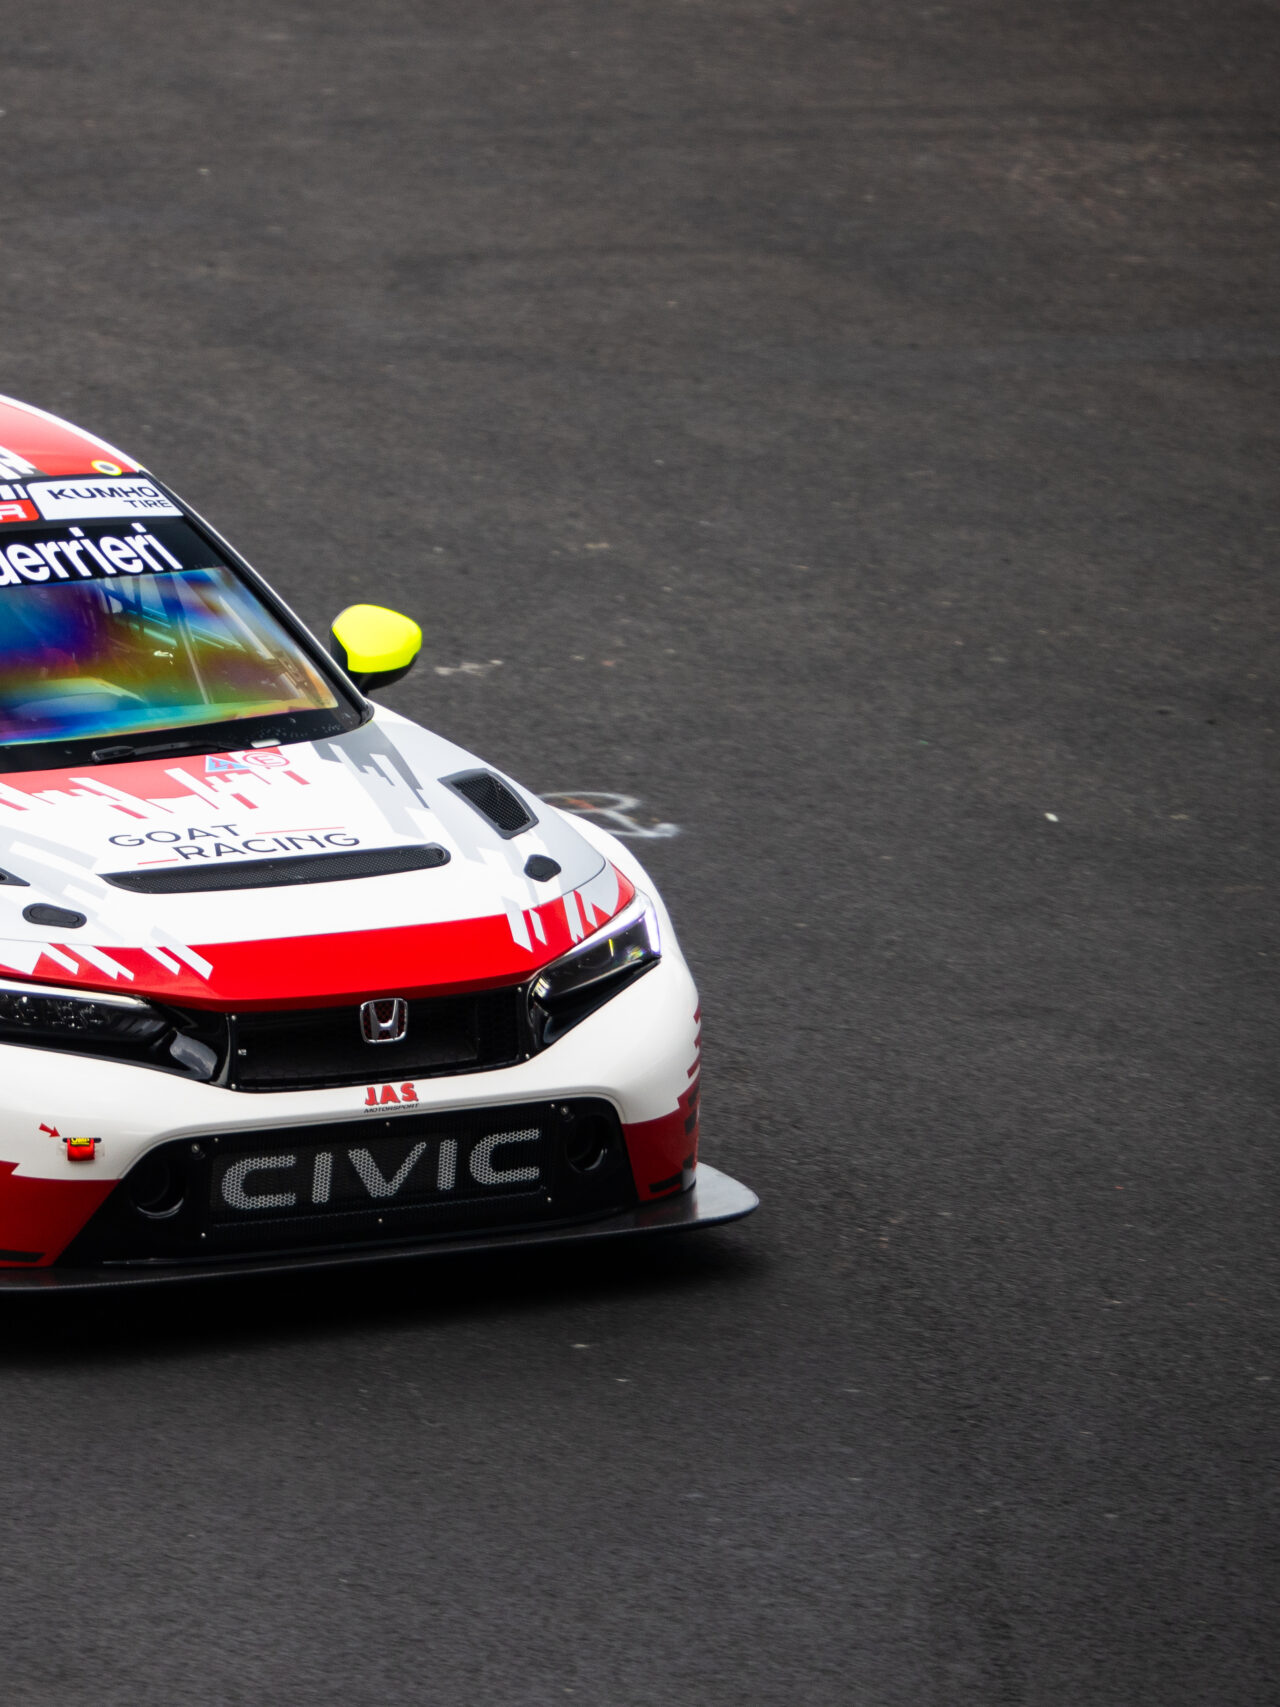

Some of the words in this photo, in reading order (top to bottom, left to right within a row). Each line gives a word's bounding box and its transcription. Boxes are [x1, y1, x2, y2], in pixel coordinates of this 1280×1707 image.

[47, 486, 159, 500] KUMHO
[123, 499, 173, 509] TIRE
[108, 823, 241, 847] GOAT
[172, 833, 360, 860] RACING
[364, 1082, 419, 1106] JAS
[222, 1128, 540, 1209] CIVIC
